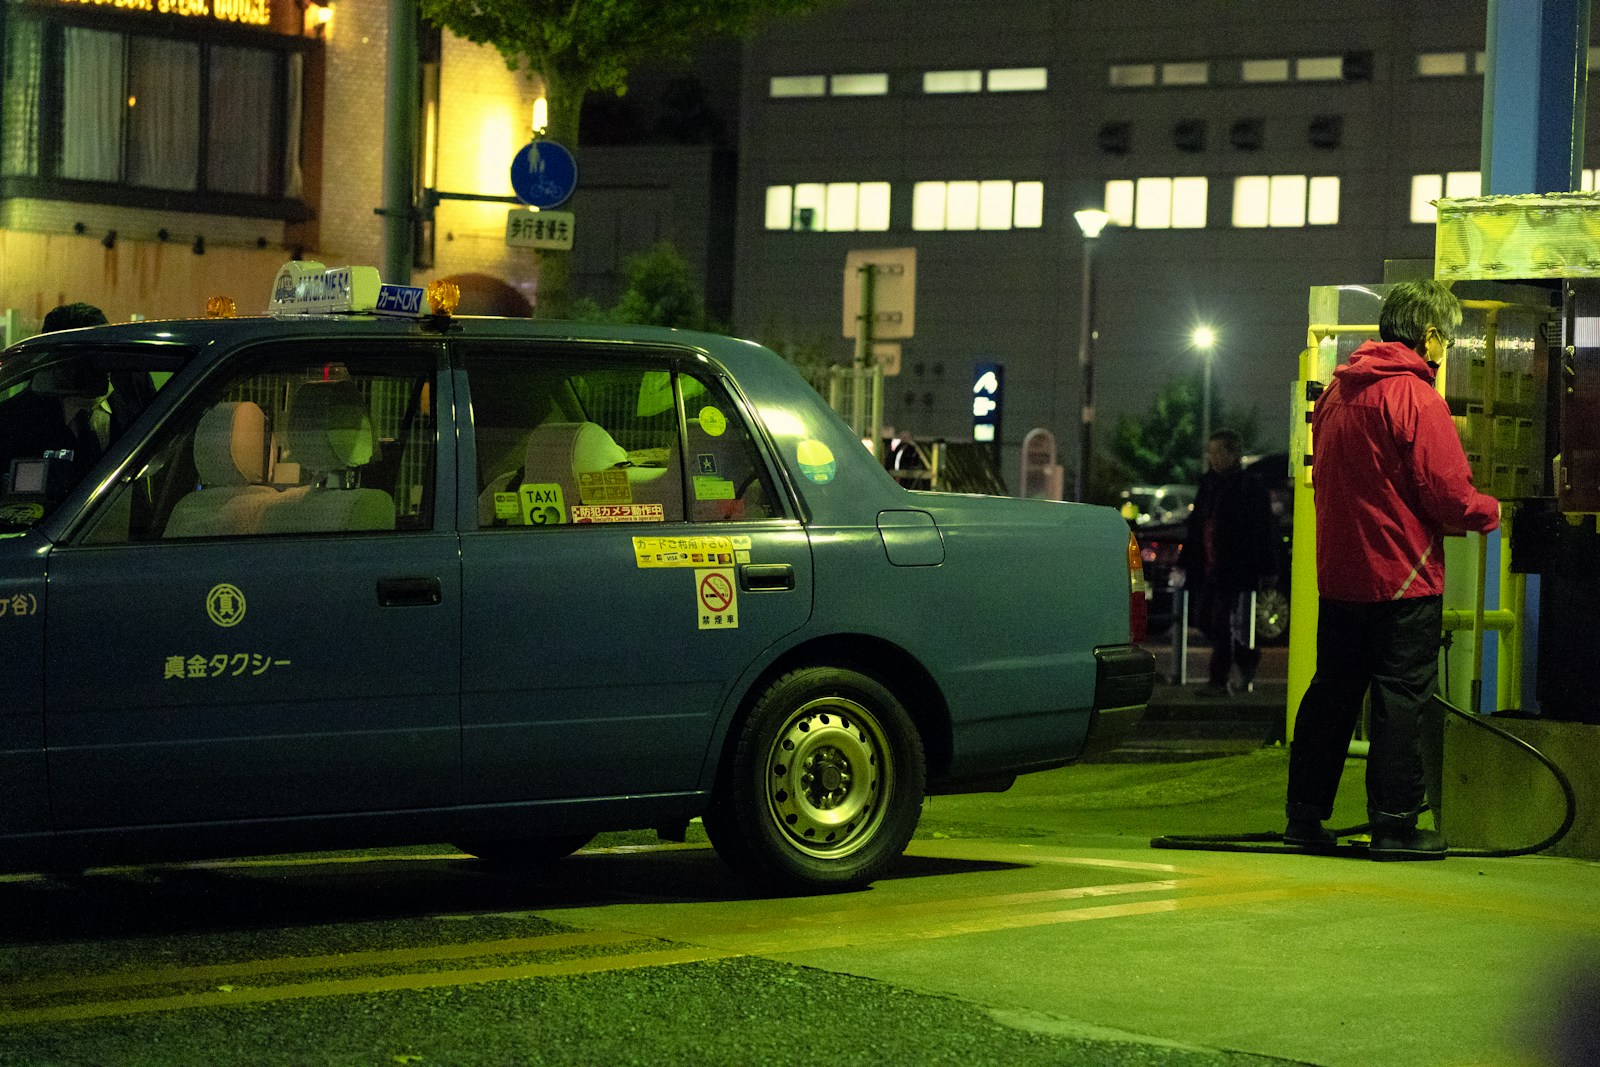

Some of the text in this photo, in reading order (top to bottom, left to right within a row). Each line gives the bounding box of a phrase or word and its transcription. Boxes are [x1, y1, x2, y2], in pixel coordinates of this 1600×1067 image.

[377, 287, 422, 312] カードOK
[526, 490, 557, 503] TAXI
[530, 506, 560, 525] GO
[580, 506, 662, 517] 防犯カメラ動作中
[637, 539, 728, 550] カードご利用下さい
[702, 614, 735, 625] 禁煙車
